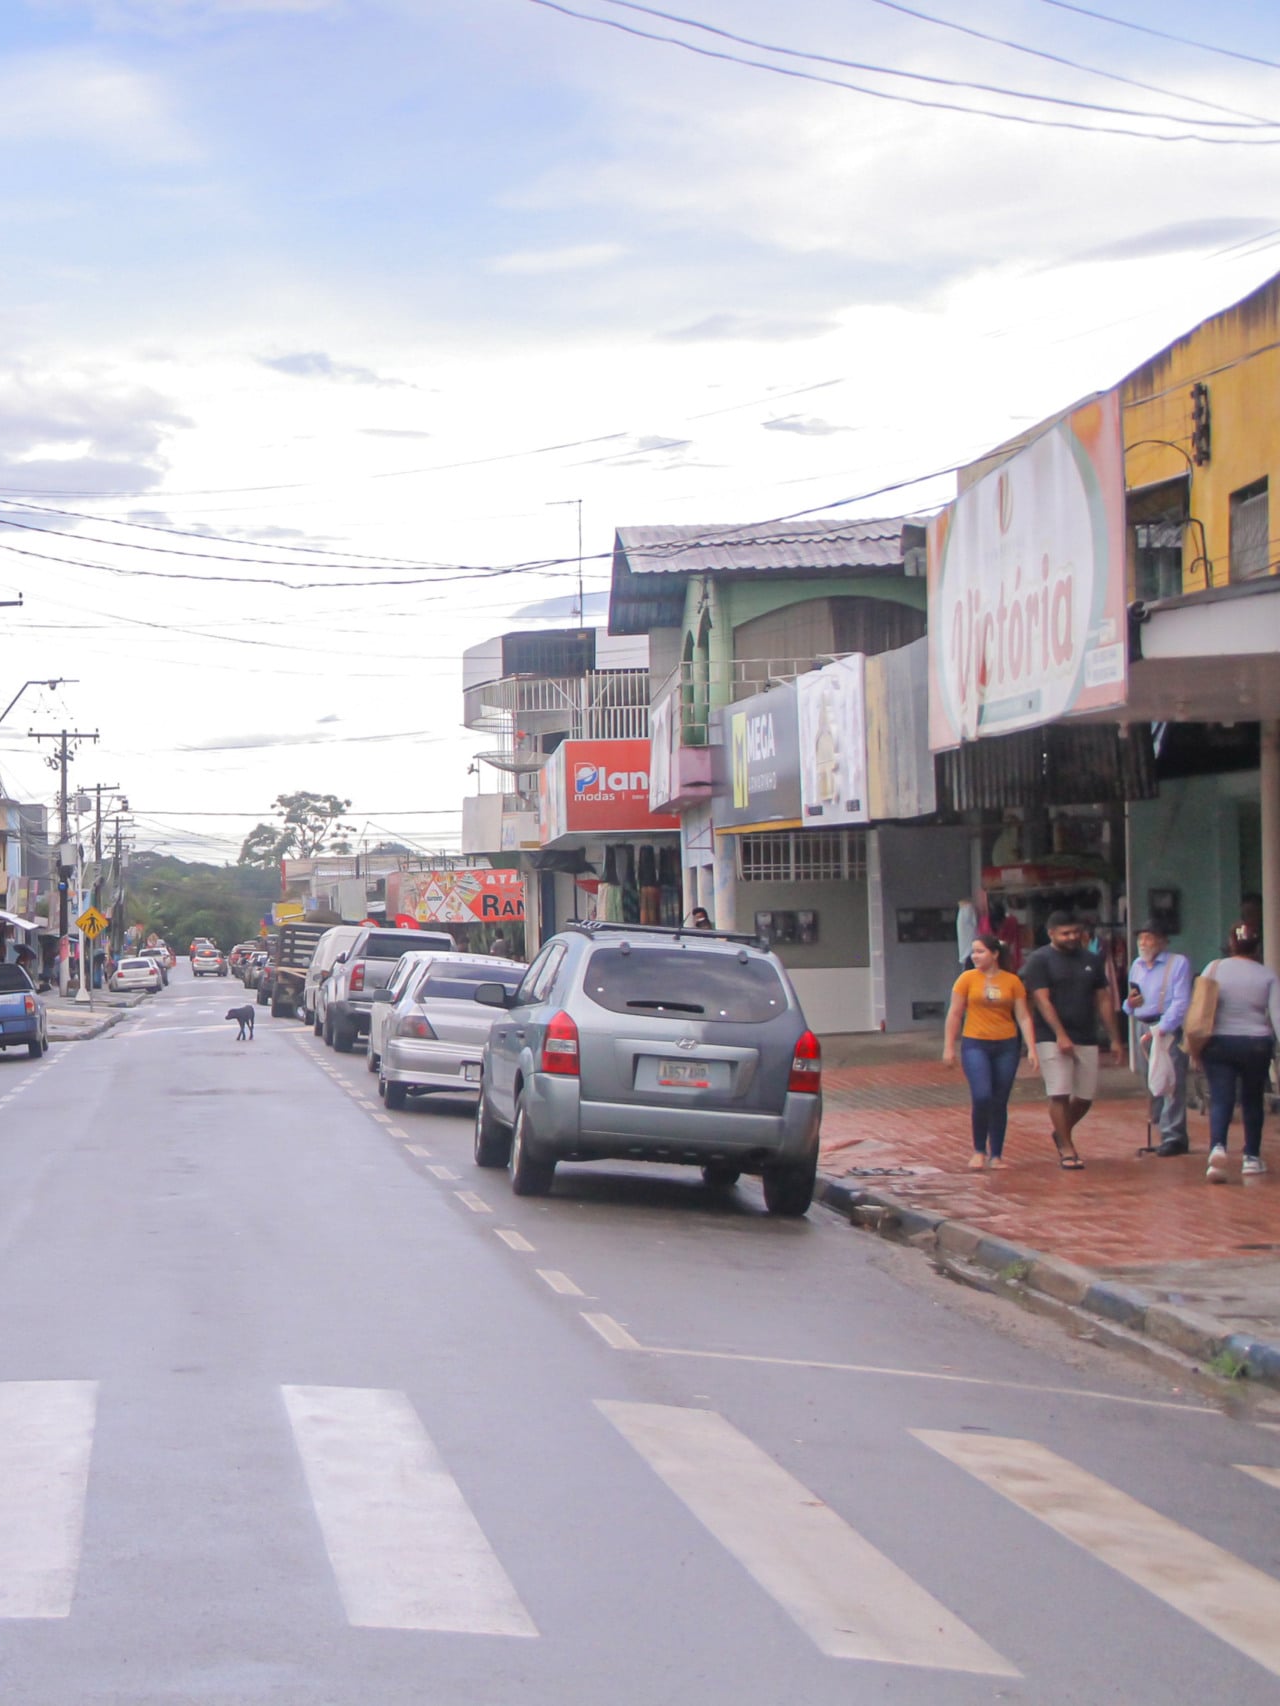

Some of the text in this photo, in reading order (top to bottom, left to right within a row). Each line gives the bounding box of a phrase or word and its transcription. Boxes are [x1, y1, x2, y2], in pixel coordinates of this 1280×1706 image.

[951, 552, 1073, 705] Victória
[746, 712, 776, 764] MEGA
[574, 762, 651, 793] Plan
[574, 792, 616, 801] modas
